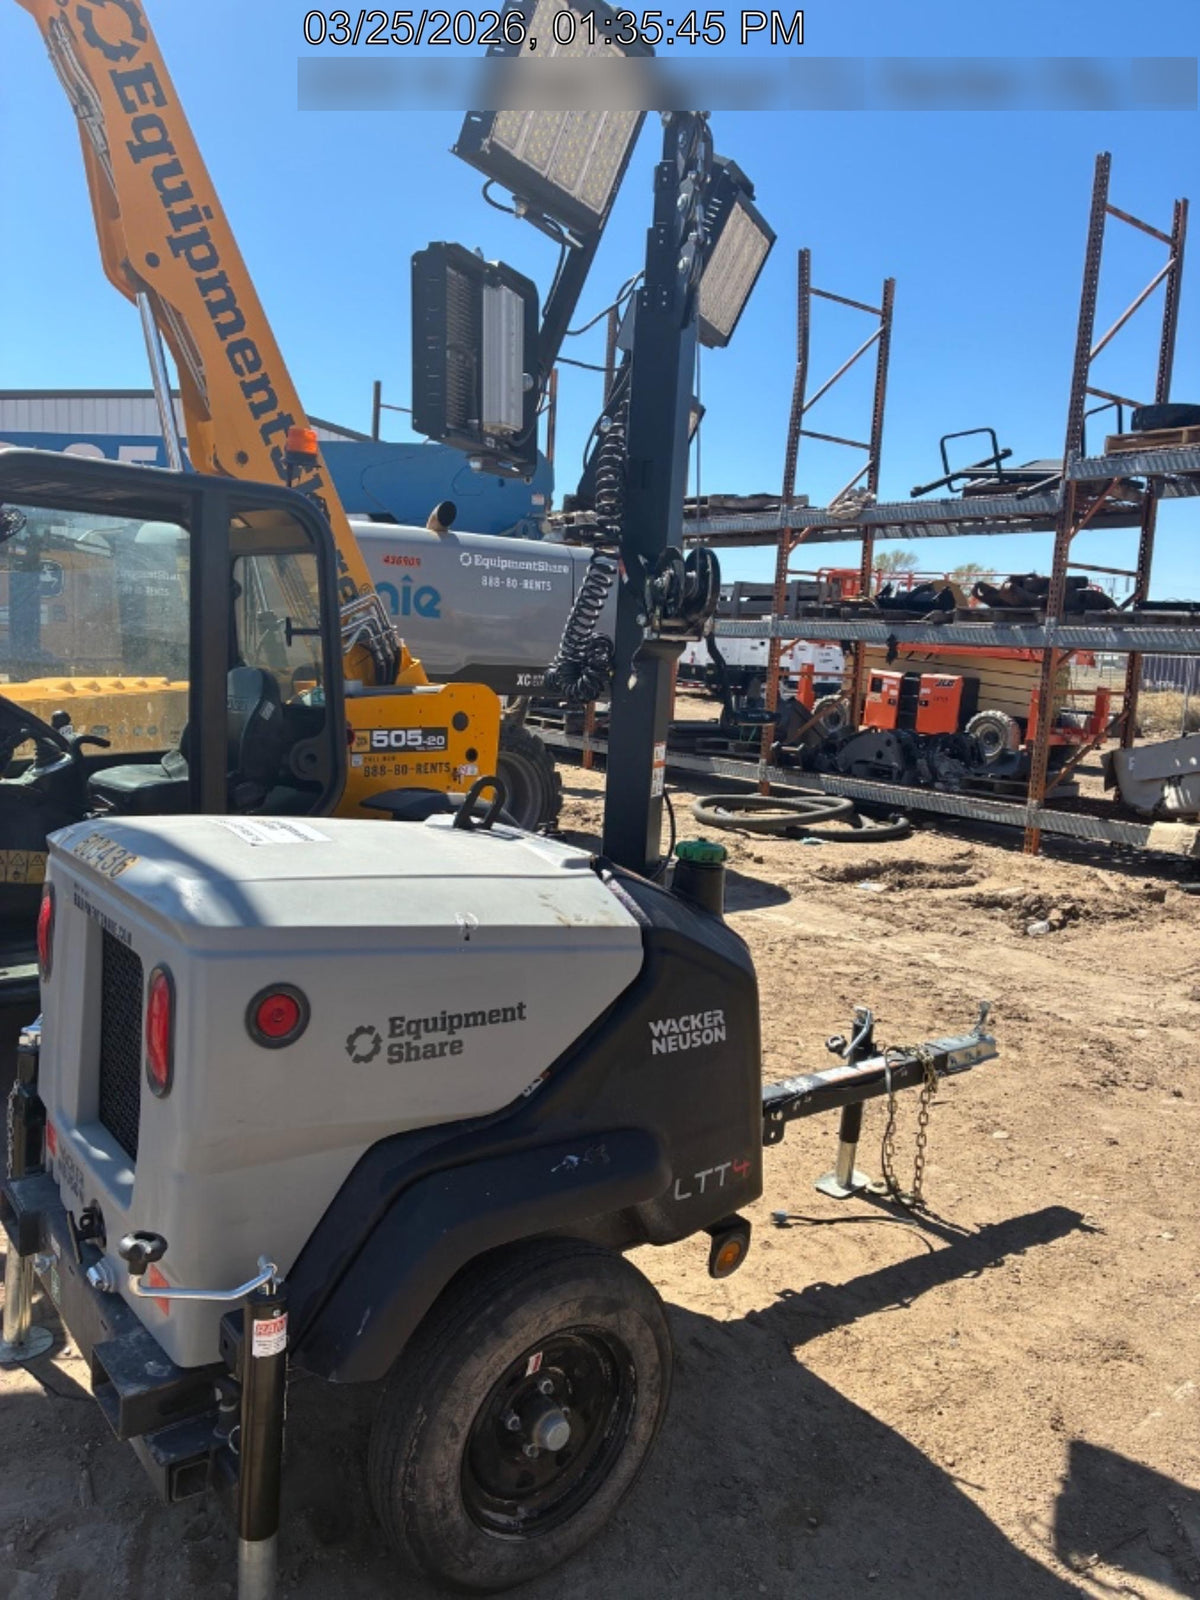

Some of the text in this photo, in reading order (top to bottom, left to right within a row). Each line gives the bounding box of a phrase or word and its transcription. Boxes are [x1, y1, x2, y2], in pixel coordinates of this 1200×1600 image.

[473, 554, 570, 574] EquipmentShare
[481, 575, 552, 592] 888-80-RENTS
[363, 762, 451, 778] 888-80-RENTS
[388, 1001, 527, 1040] Equipment
[648, 1009, 726, 1037] WACKER
[387, 1039, 464, 1065] Share
[651, 1025, 726, 1055] NEUSON
[674, 1159, 751, 1201] LTT4
